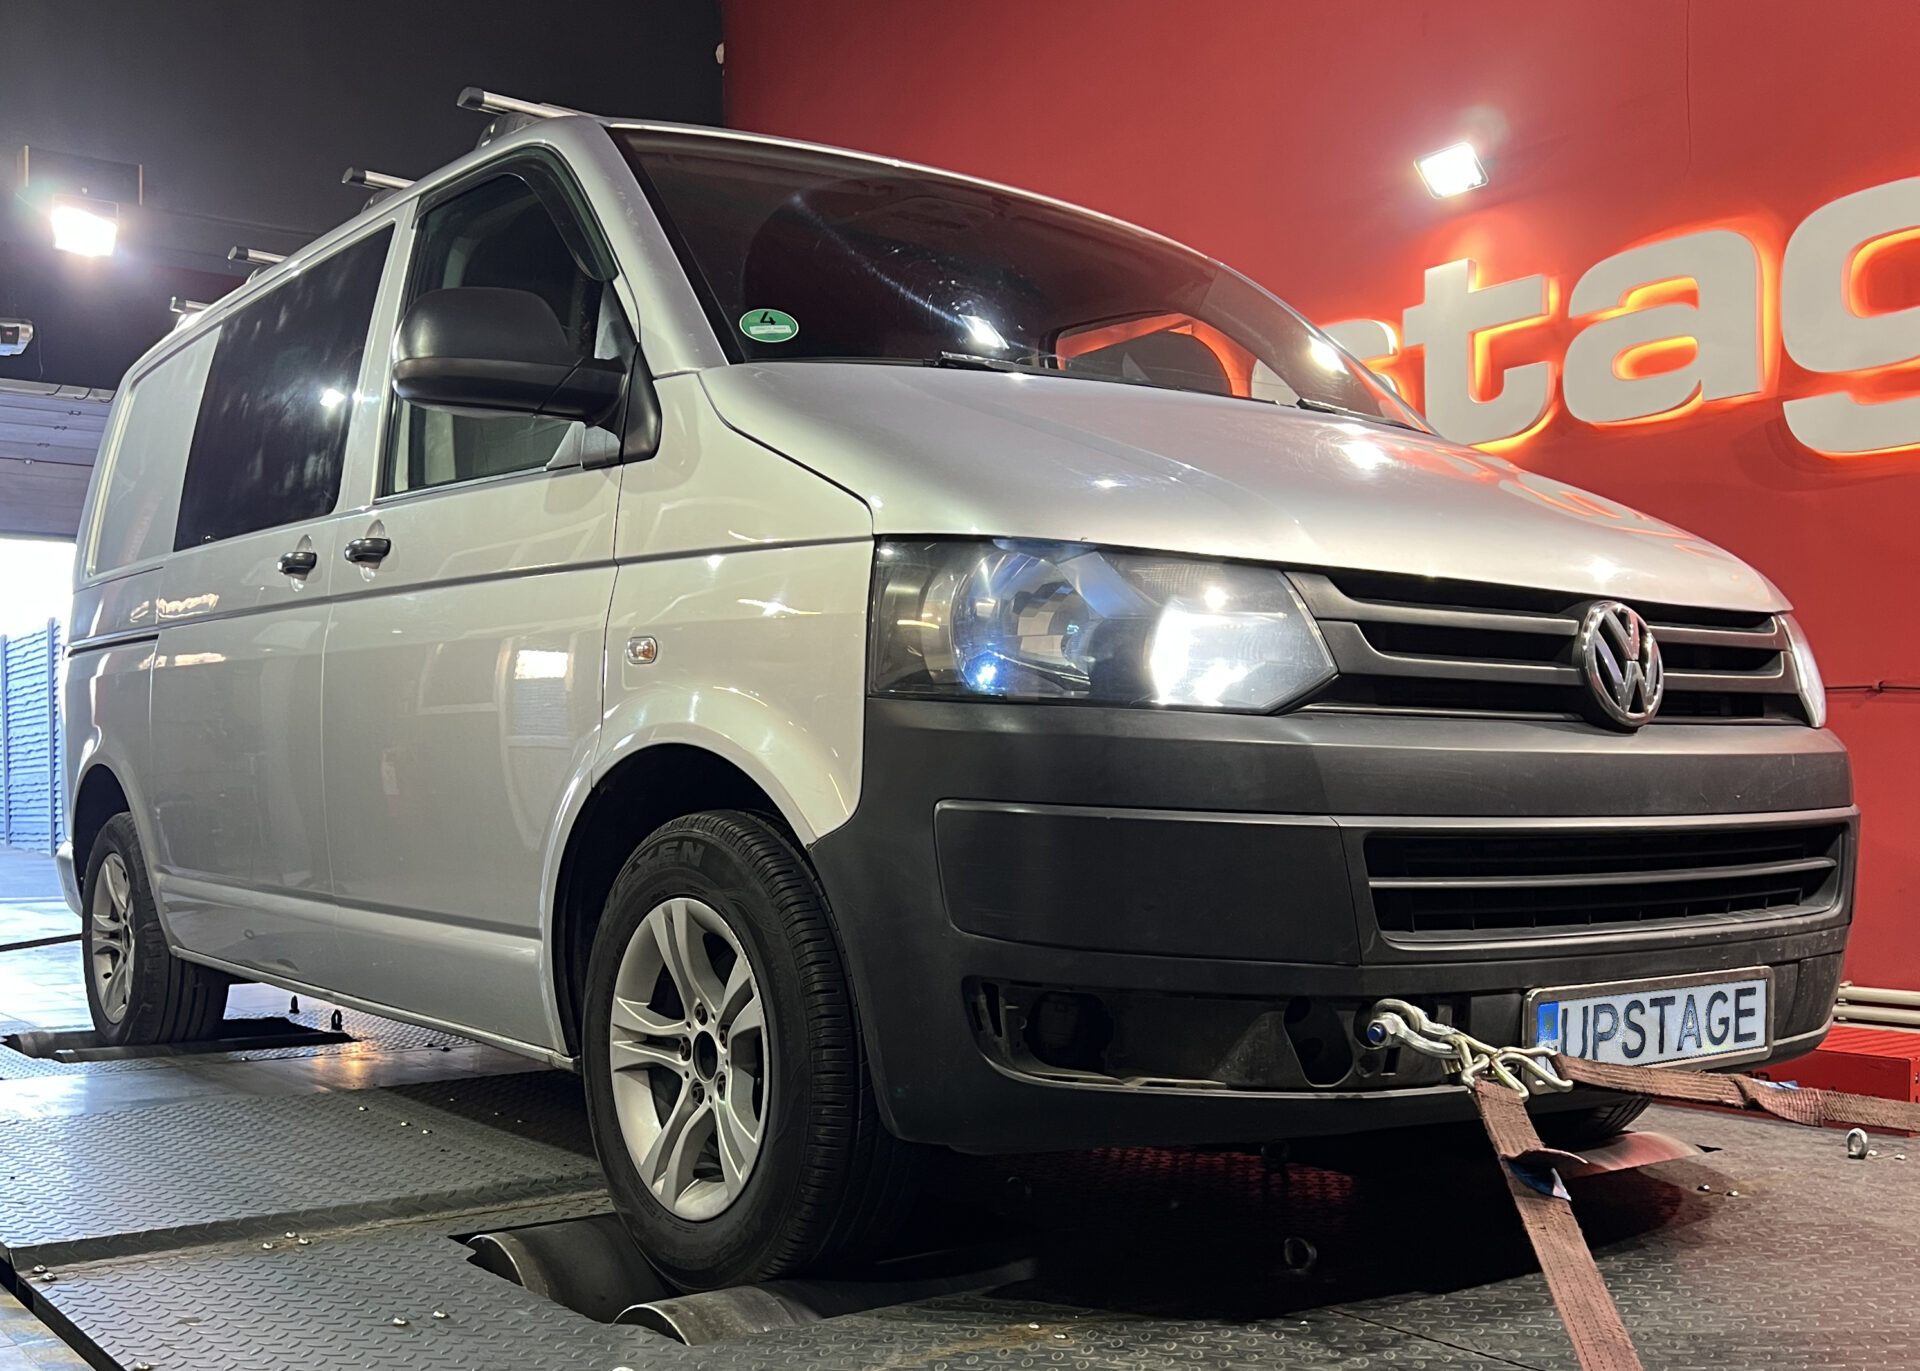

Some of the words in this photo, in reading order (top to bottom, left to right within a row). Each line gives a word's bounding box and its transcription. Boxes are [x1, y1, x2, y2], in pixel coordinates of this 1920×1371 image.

[760, 311, 776, 325] 4
[1583, 601, 1663, 722] VW
[1561, 987, 1757, 1061] UPSTAGE
